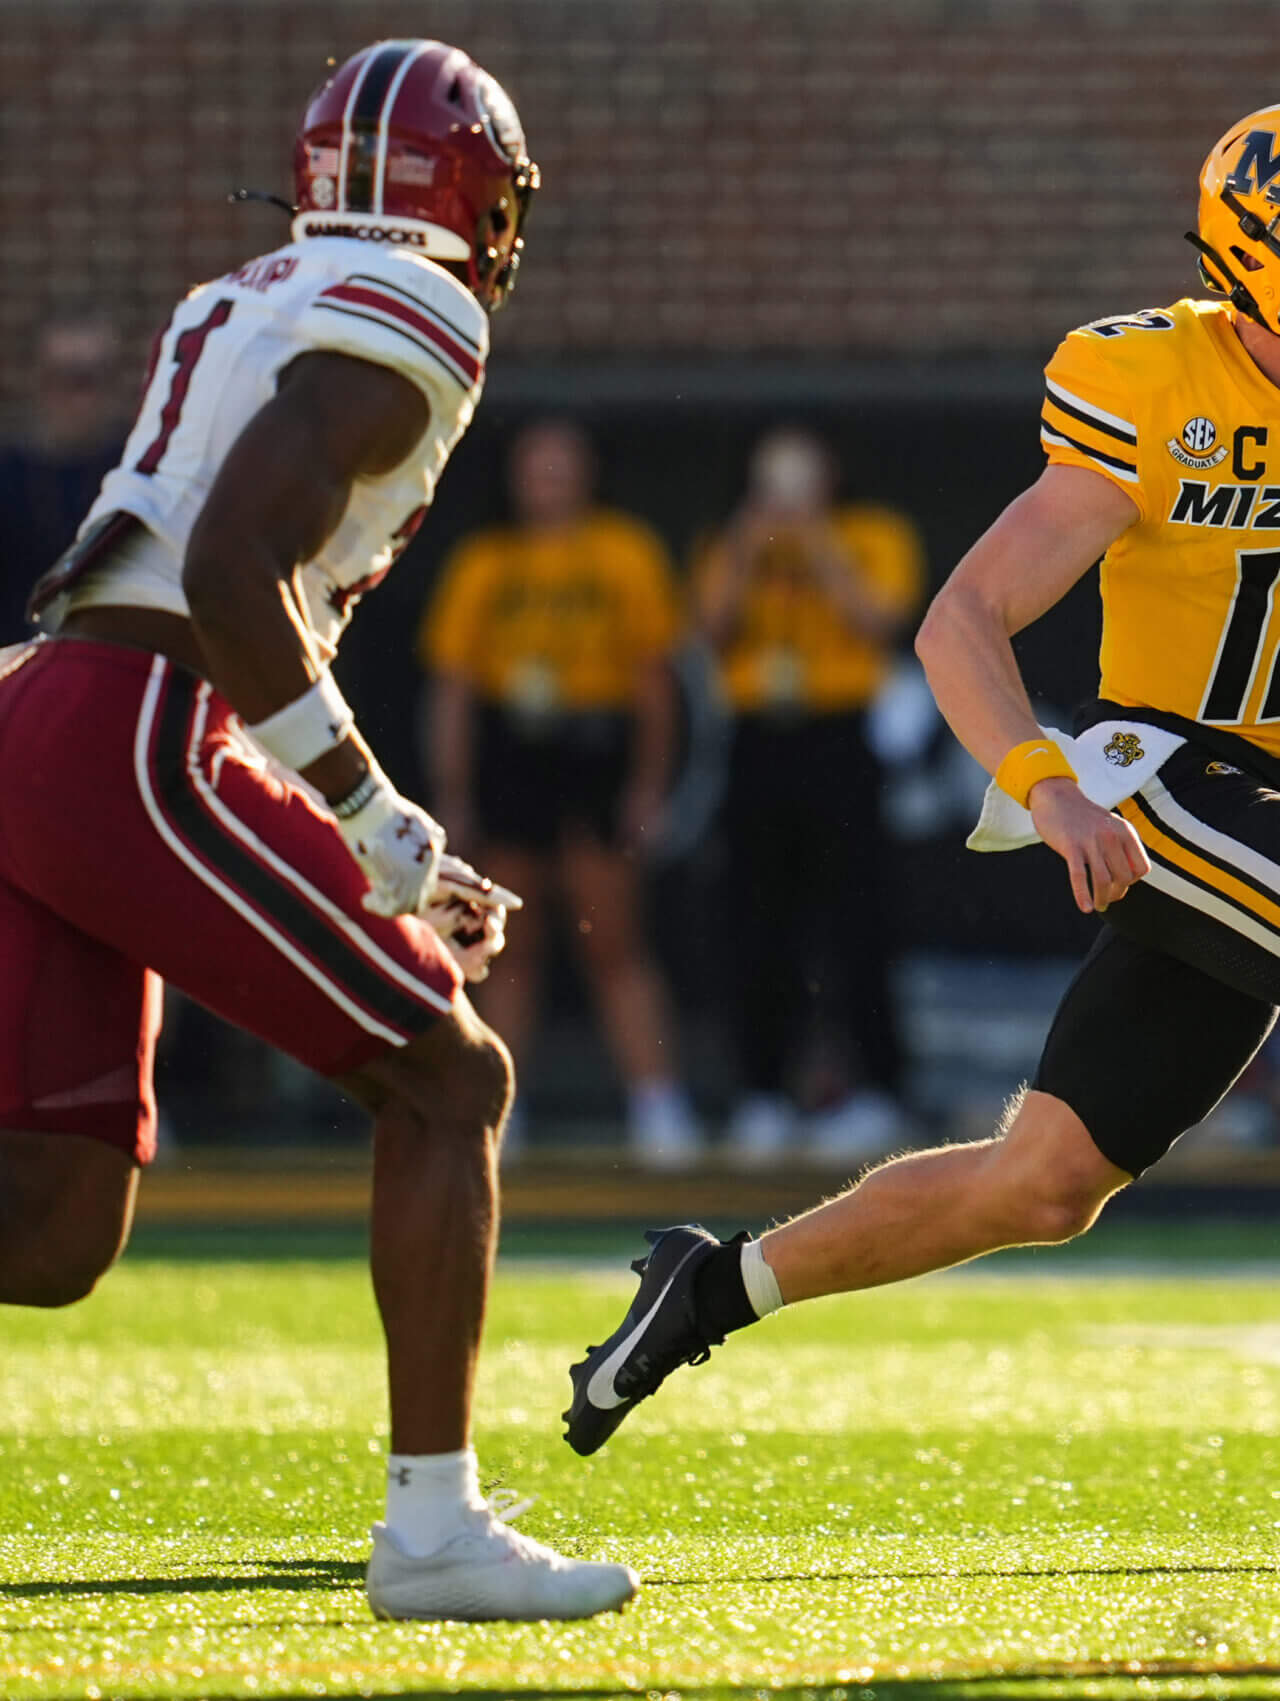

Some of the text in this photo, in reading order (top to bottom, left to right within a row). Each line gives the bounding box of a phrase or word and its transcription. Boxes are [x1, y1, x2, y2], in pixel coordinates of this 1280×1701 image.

[1184, 417, 1216, 451] SEC
[1171, 446, 1220, 468] GRADUATE
[1232, 426, 1268, 481] C
